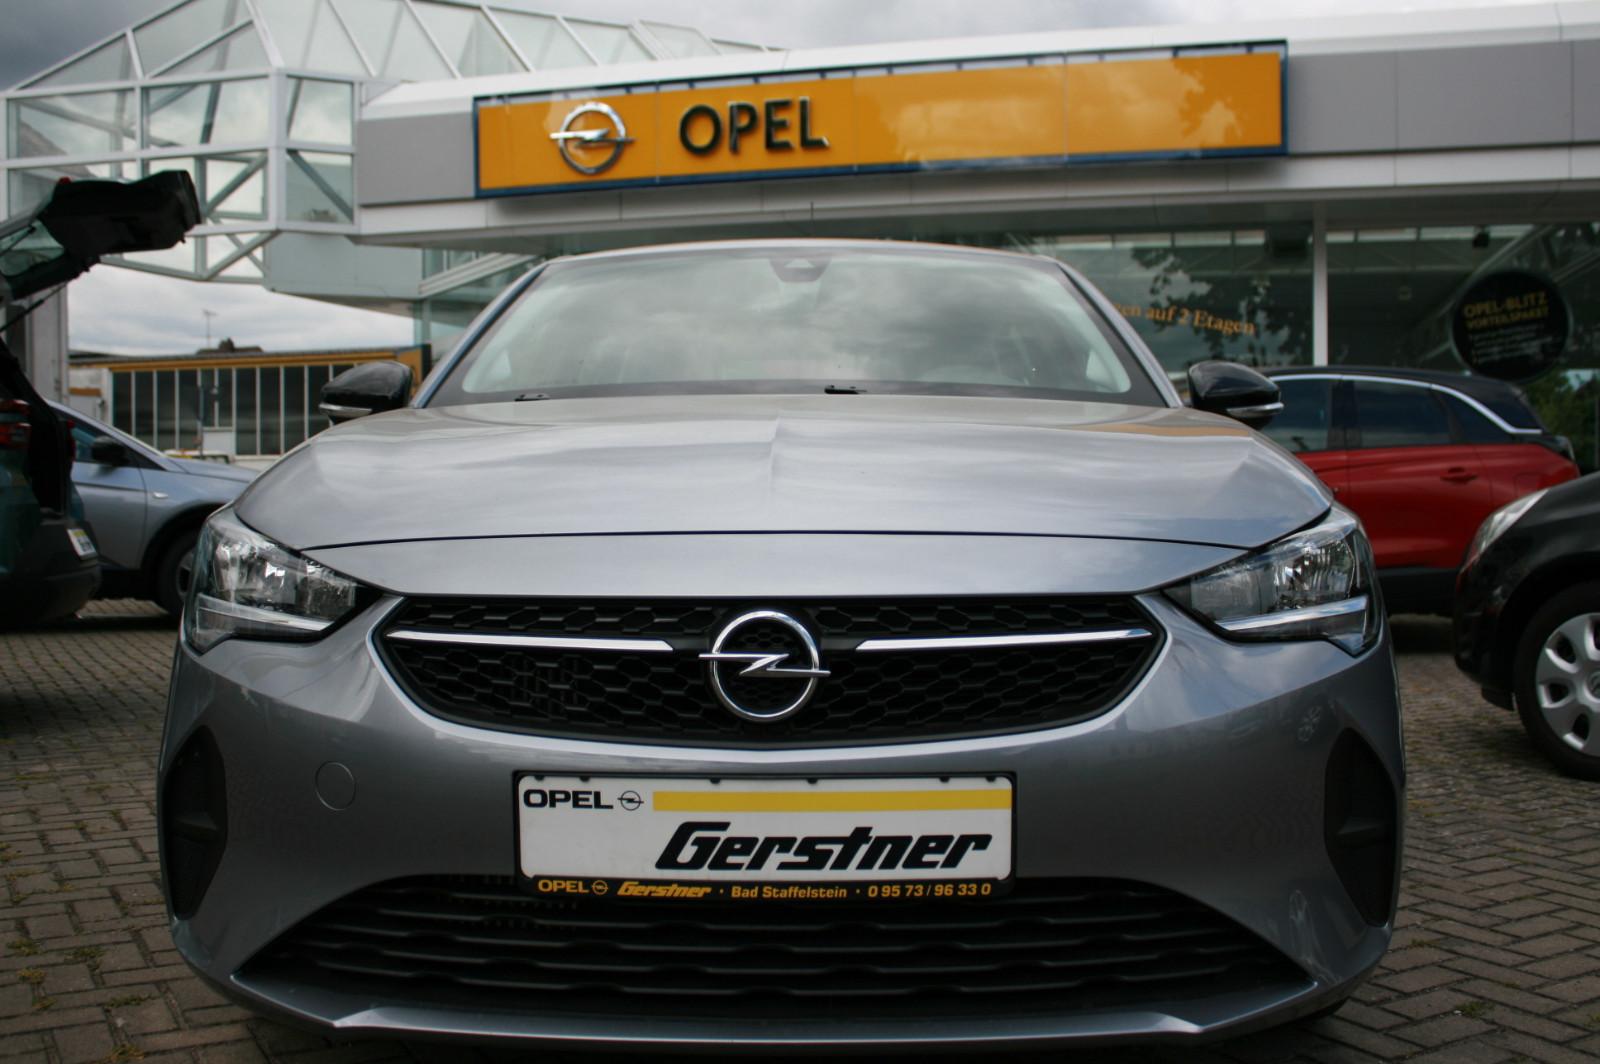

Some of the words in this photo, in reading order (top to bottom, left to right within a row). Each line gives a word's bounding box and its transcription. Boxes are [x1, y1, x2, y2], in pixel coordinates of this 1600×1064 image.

[679, 96, 831, 157] OPEL
[1146, 305, 1177, 321] auf
[1178, 308, 1190, 325] 2
[1193, 309, 1257, 336] Etagen
[523, 789, 614, 810] OPEL
[655, 821, 993, 871] Gerstner
[537, 879, 589, 893] OPEL
[617, 881, 712, 897] Gerstner
[731, 885, 757, 898] Bad
[762, 886, 848, 899] Staffelstein
